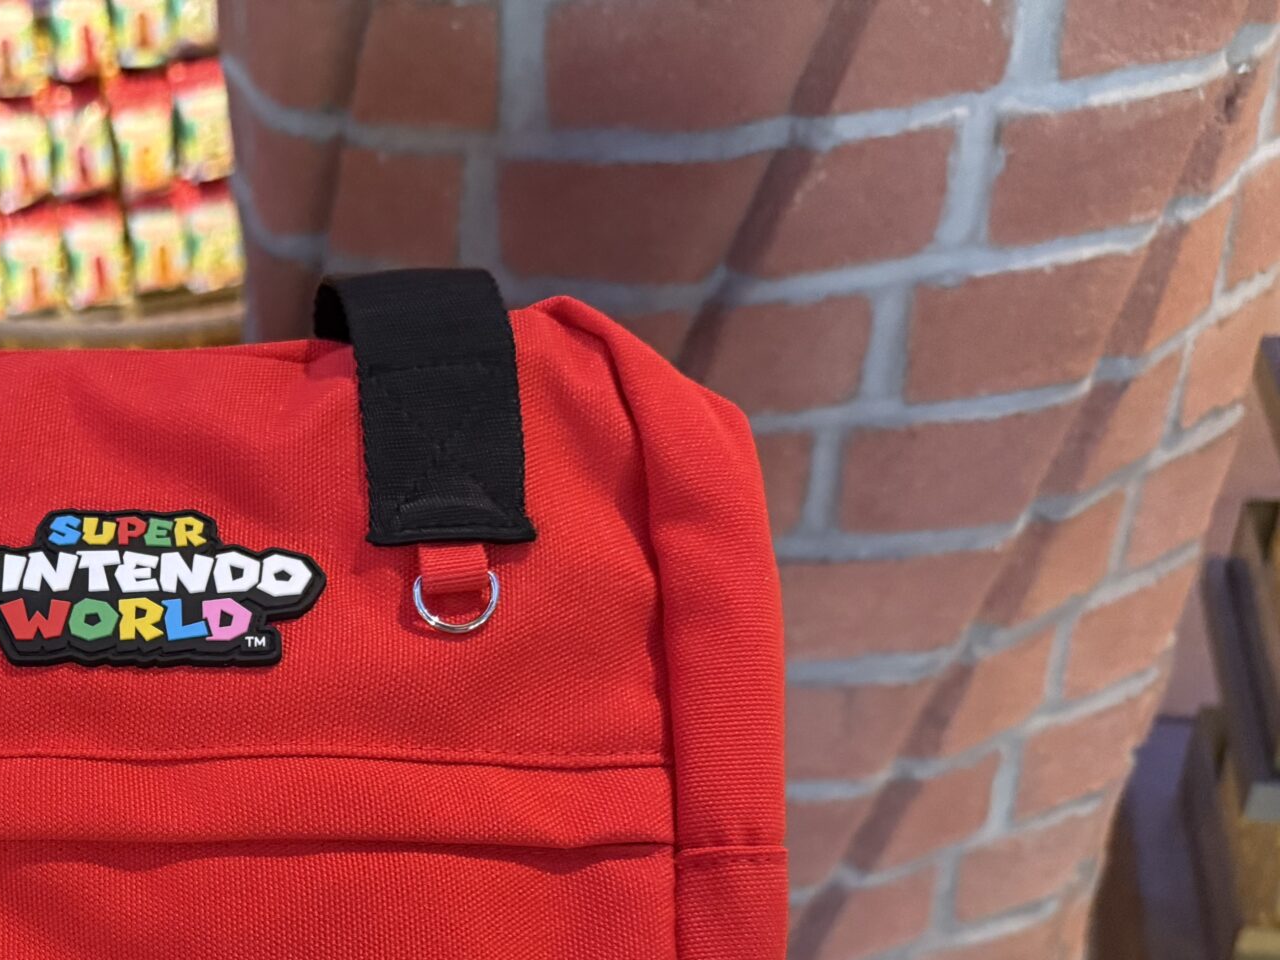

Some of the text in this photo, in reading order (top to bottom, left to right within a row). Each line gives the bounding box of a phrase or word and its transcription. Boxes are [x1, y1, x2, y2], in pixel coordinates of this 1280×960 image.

[48, 516, 208, 547] SUPER
[0, 597, 266, 648] WORLD TM
